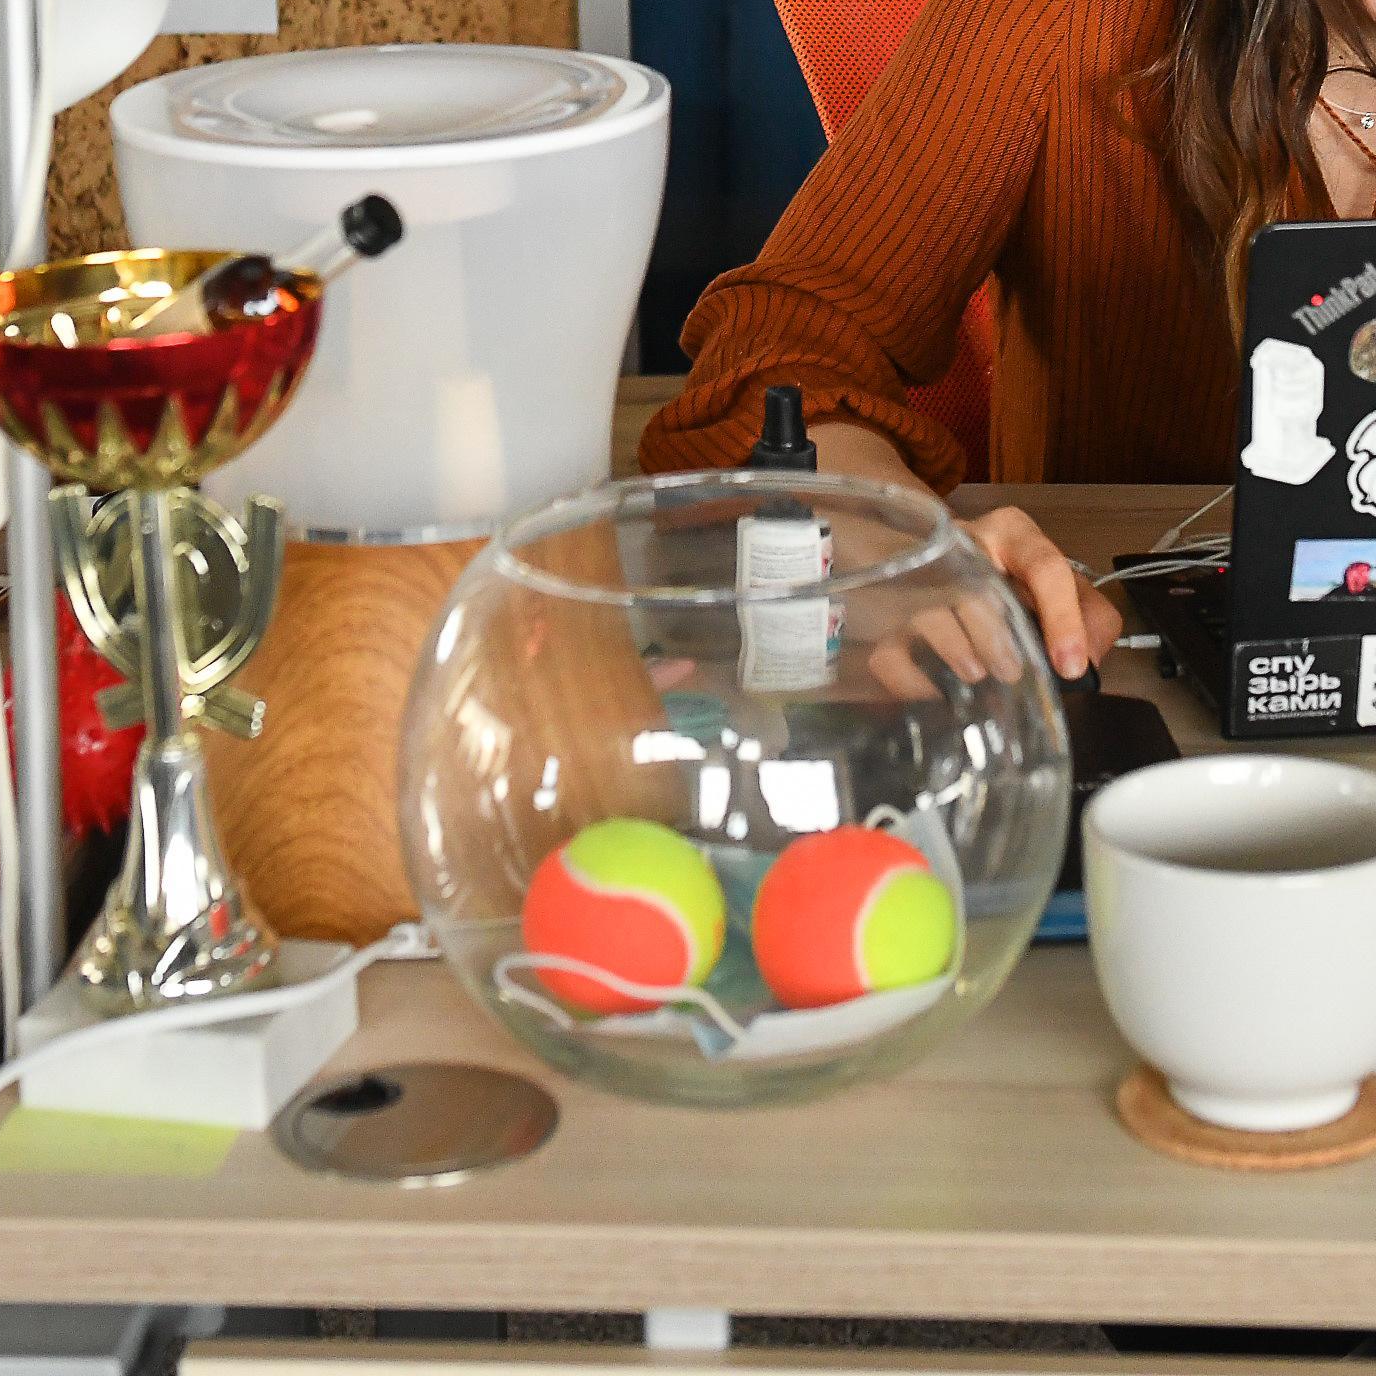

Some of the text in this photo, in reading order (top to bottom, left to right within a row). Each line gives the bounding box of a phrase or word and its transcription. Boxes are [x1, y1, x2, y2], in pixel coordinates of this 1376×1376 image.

[1248, 654, 1316, 675] спу
[1247, 673, 1342, 695] зырь
[1247, 691, 1343, 714] ками
